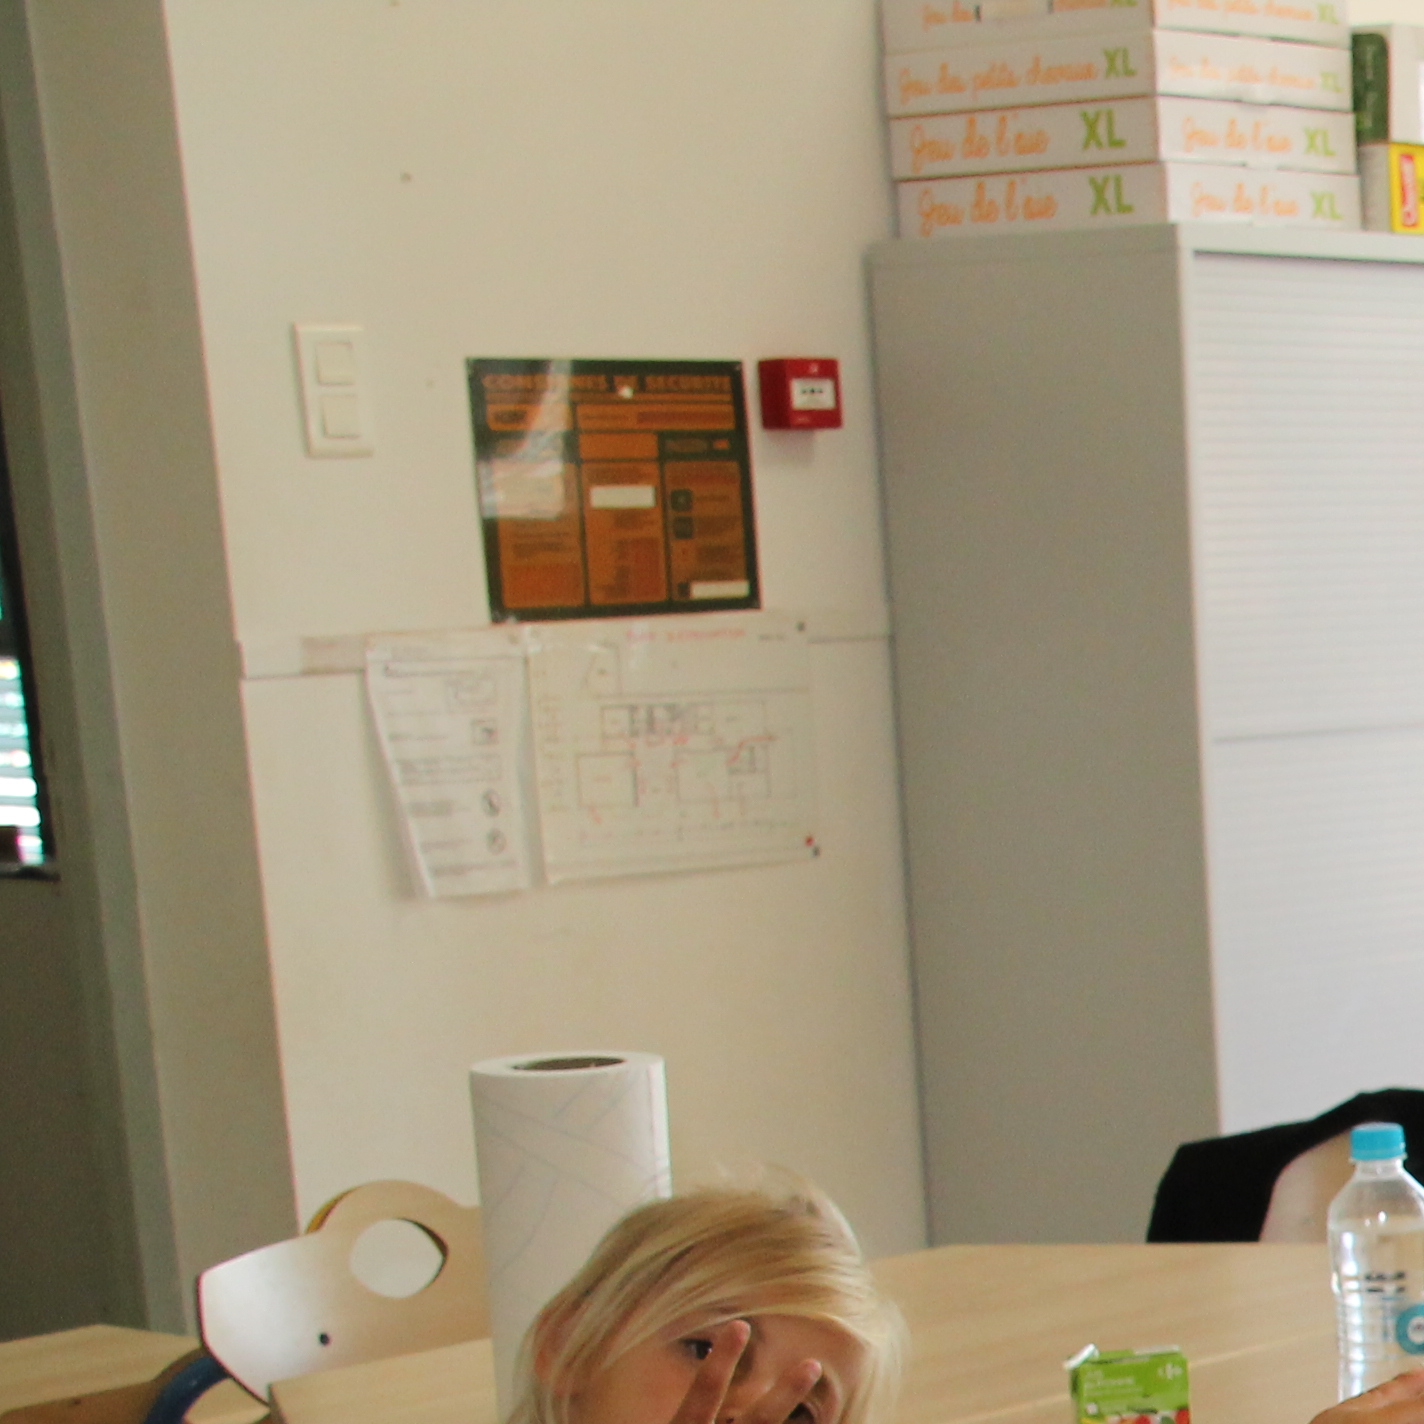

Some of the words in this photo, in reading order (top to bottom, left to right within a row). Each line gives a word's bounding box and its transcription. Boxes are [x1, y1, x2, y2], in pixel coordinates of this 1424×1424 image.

[1102, 47, 1137, 78] XL
[1080, 108, 1127, 150] XL
[1304, 126, 1336, 156] XL
[1089, 174, 1134, 215] XL
[1310, 190, 1343, 220] XL
